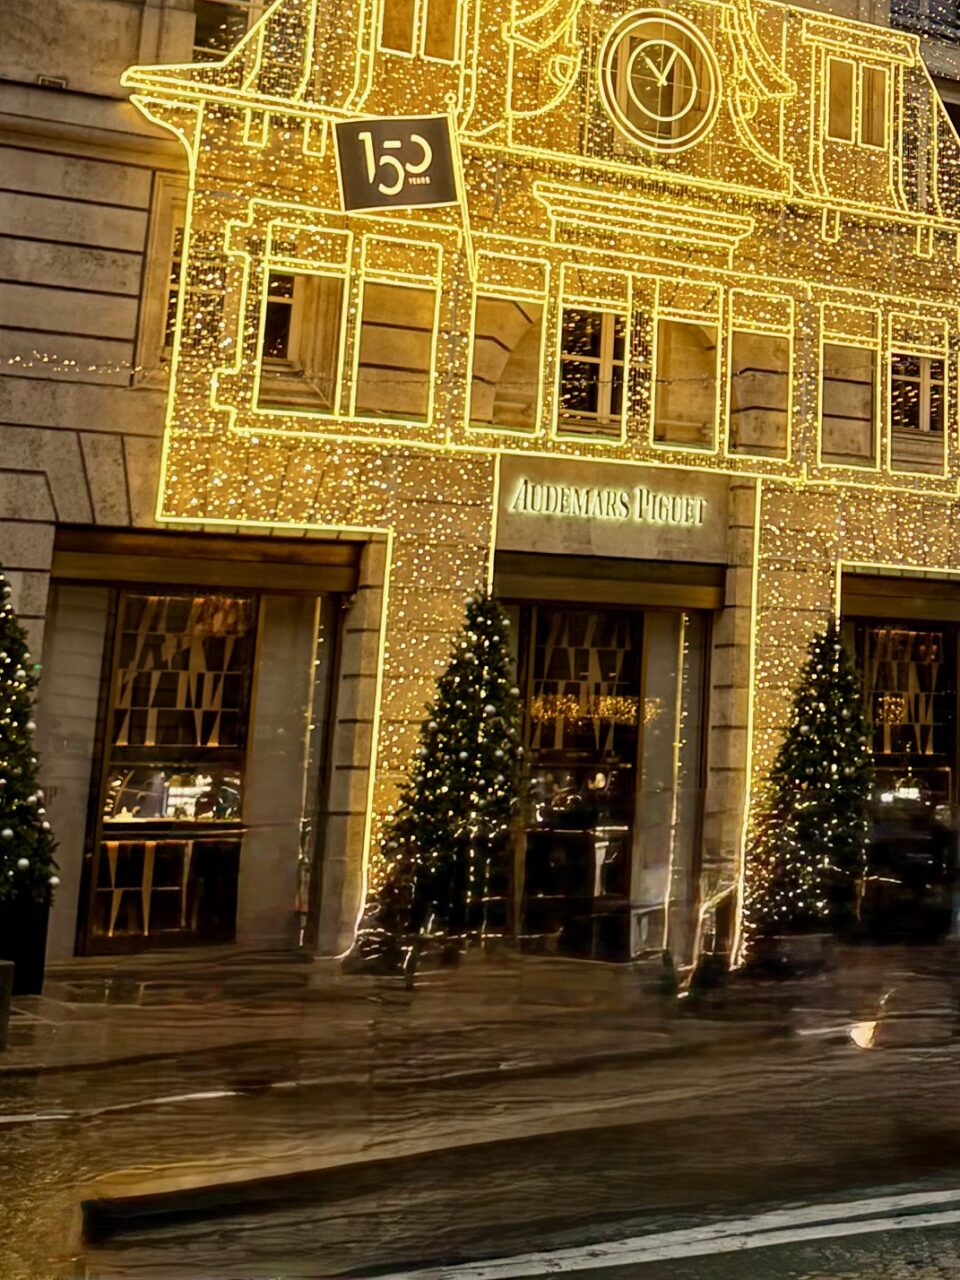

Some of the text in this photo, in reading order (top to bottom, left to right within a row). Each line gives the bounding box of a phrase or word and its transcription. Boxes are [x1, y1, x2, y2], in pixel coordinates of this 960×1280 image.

[358, 131, 433, 195] 150
[511, 477, 709, 525] AUDEMARS PIGUET
